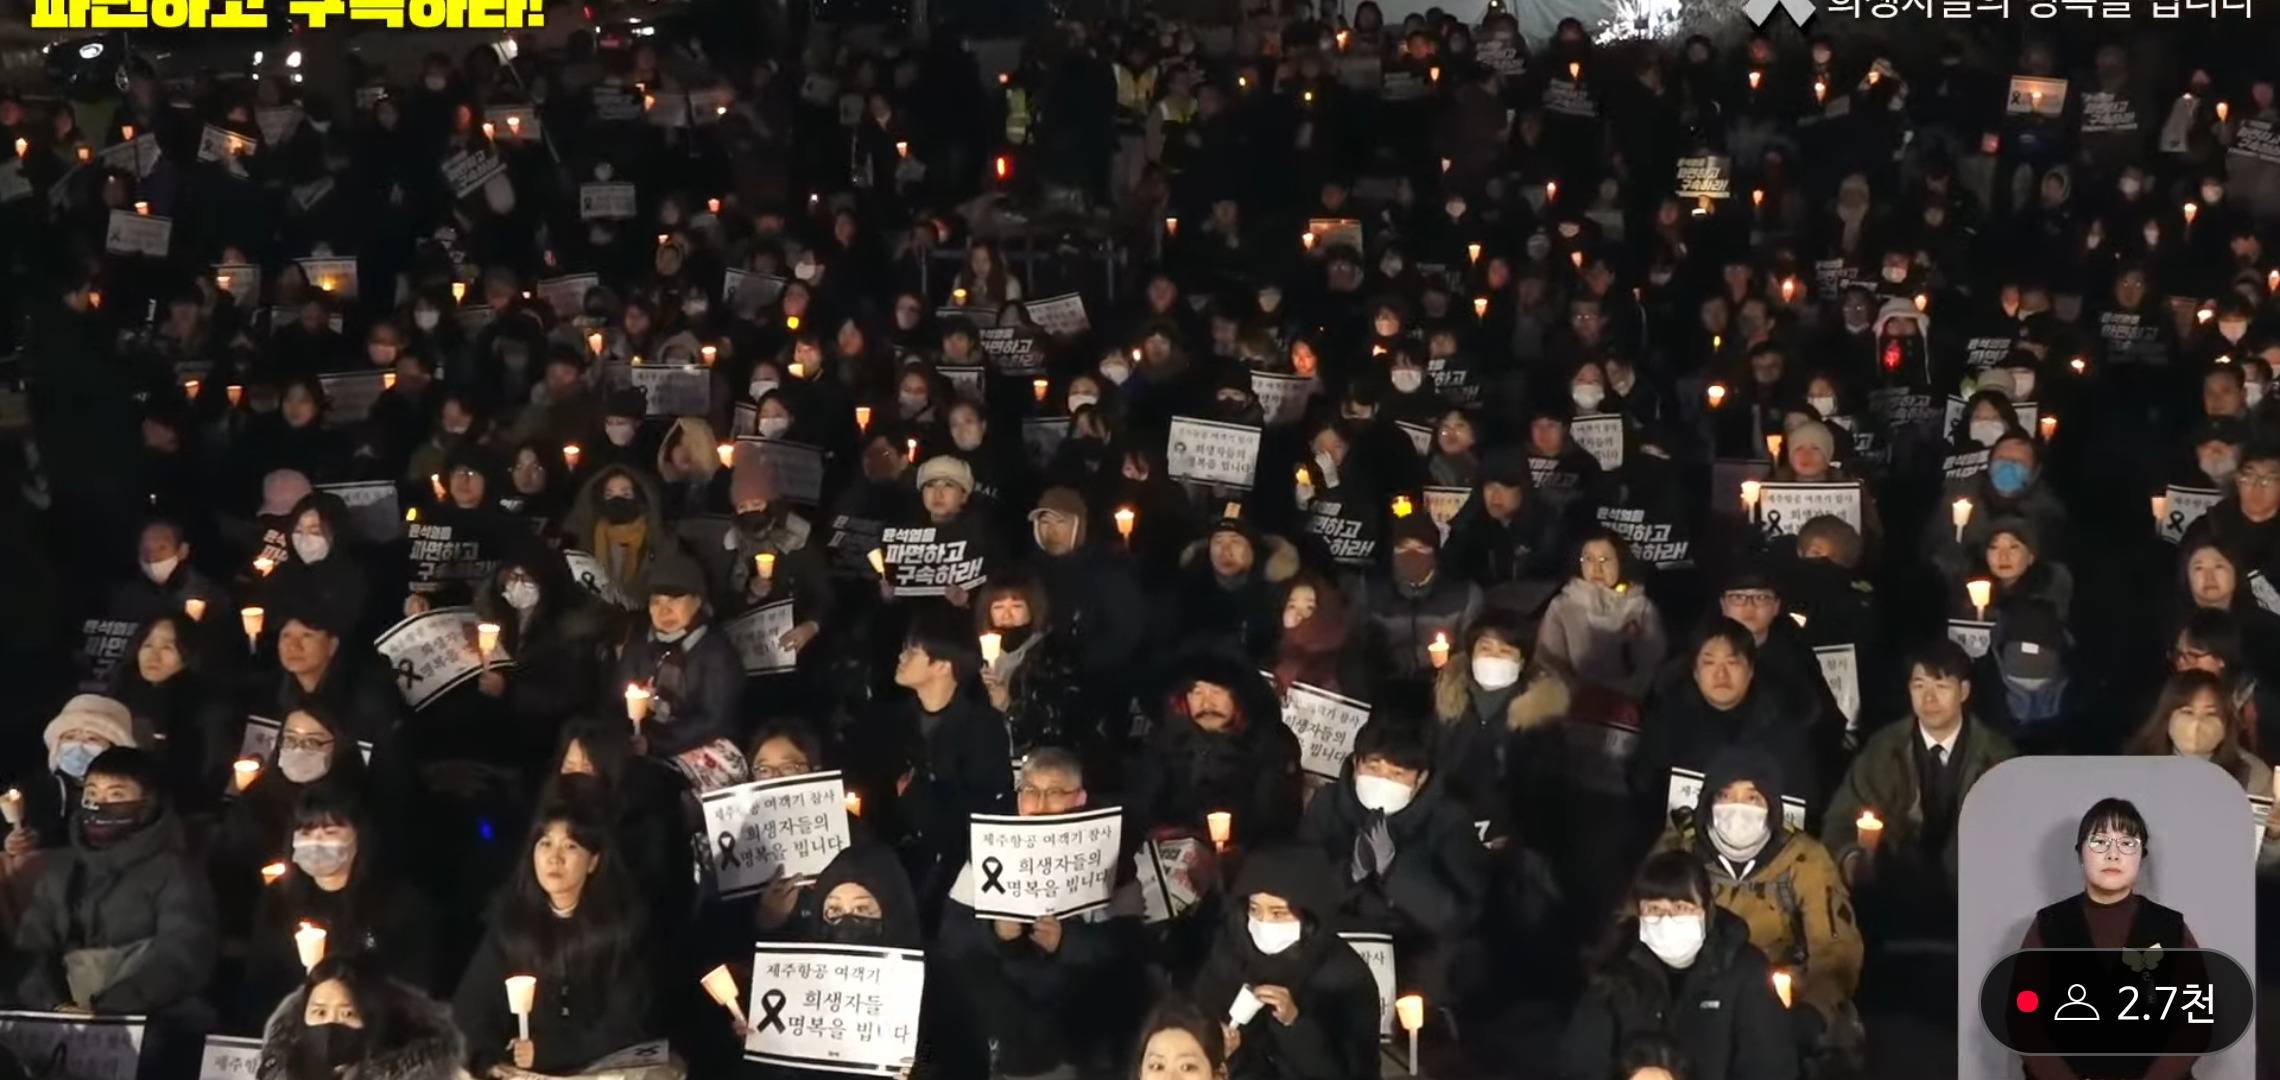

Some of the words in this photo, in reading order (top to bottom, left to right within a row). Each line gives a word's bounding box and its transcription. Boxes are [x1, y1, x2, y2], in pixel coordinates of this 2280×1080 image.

[882, 527, 937, 543] 윤석열을
[884, 540, 968, 564] 파면하고
[896, 556, 984, 586] 구속하라!
[764, 793, 805, 811] 여객기
[810, 788, 835, 805] 참사
[746, 811, 830, 842] 희생자들의
[983, 832, 1038, 849] 제주항공
[1043, 830, 1083, 847] 여객기
[1088, 825, 1112, 842] 참사
[740, 842, 788, 868] 명복을
[793, 835, 843, 859] 빕니다
[1018, 848, 1102, 876] 희생자들의
[1007, 879, 1059, 899] 명복을
[1066, 868, 1111, 894] 빕니다
[766, 962, 829, 980] 제주항공
[834, 965, 881, 985] 여객기
[788, 1014, 847, 1041] 명복을
